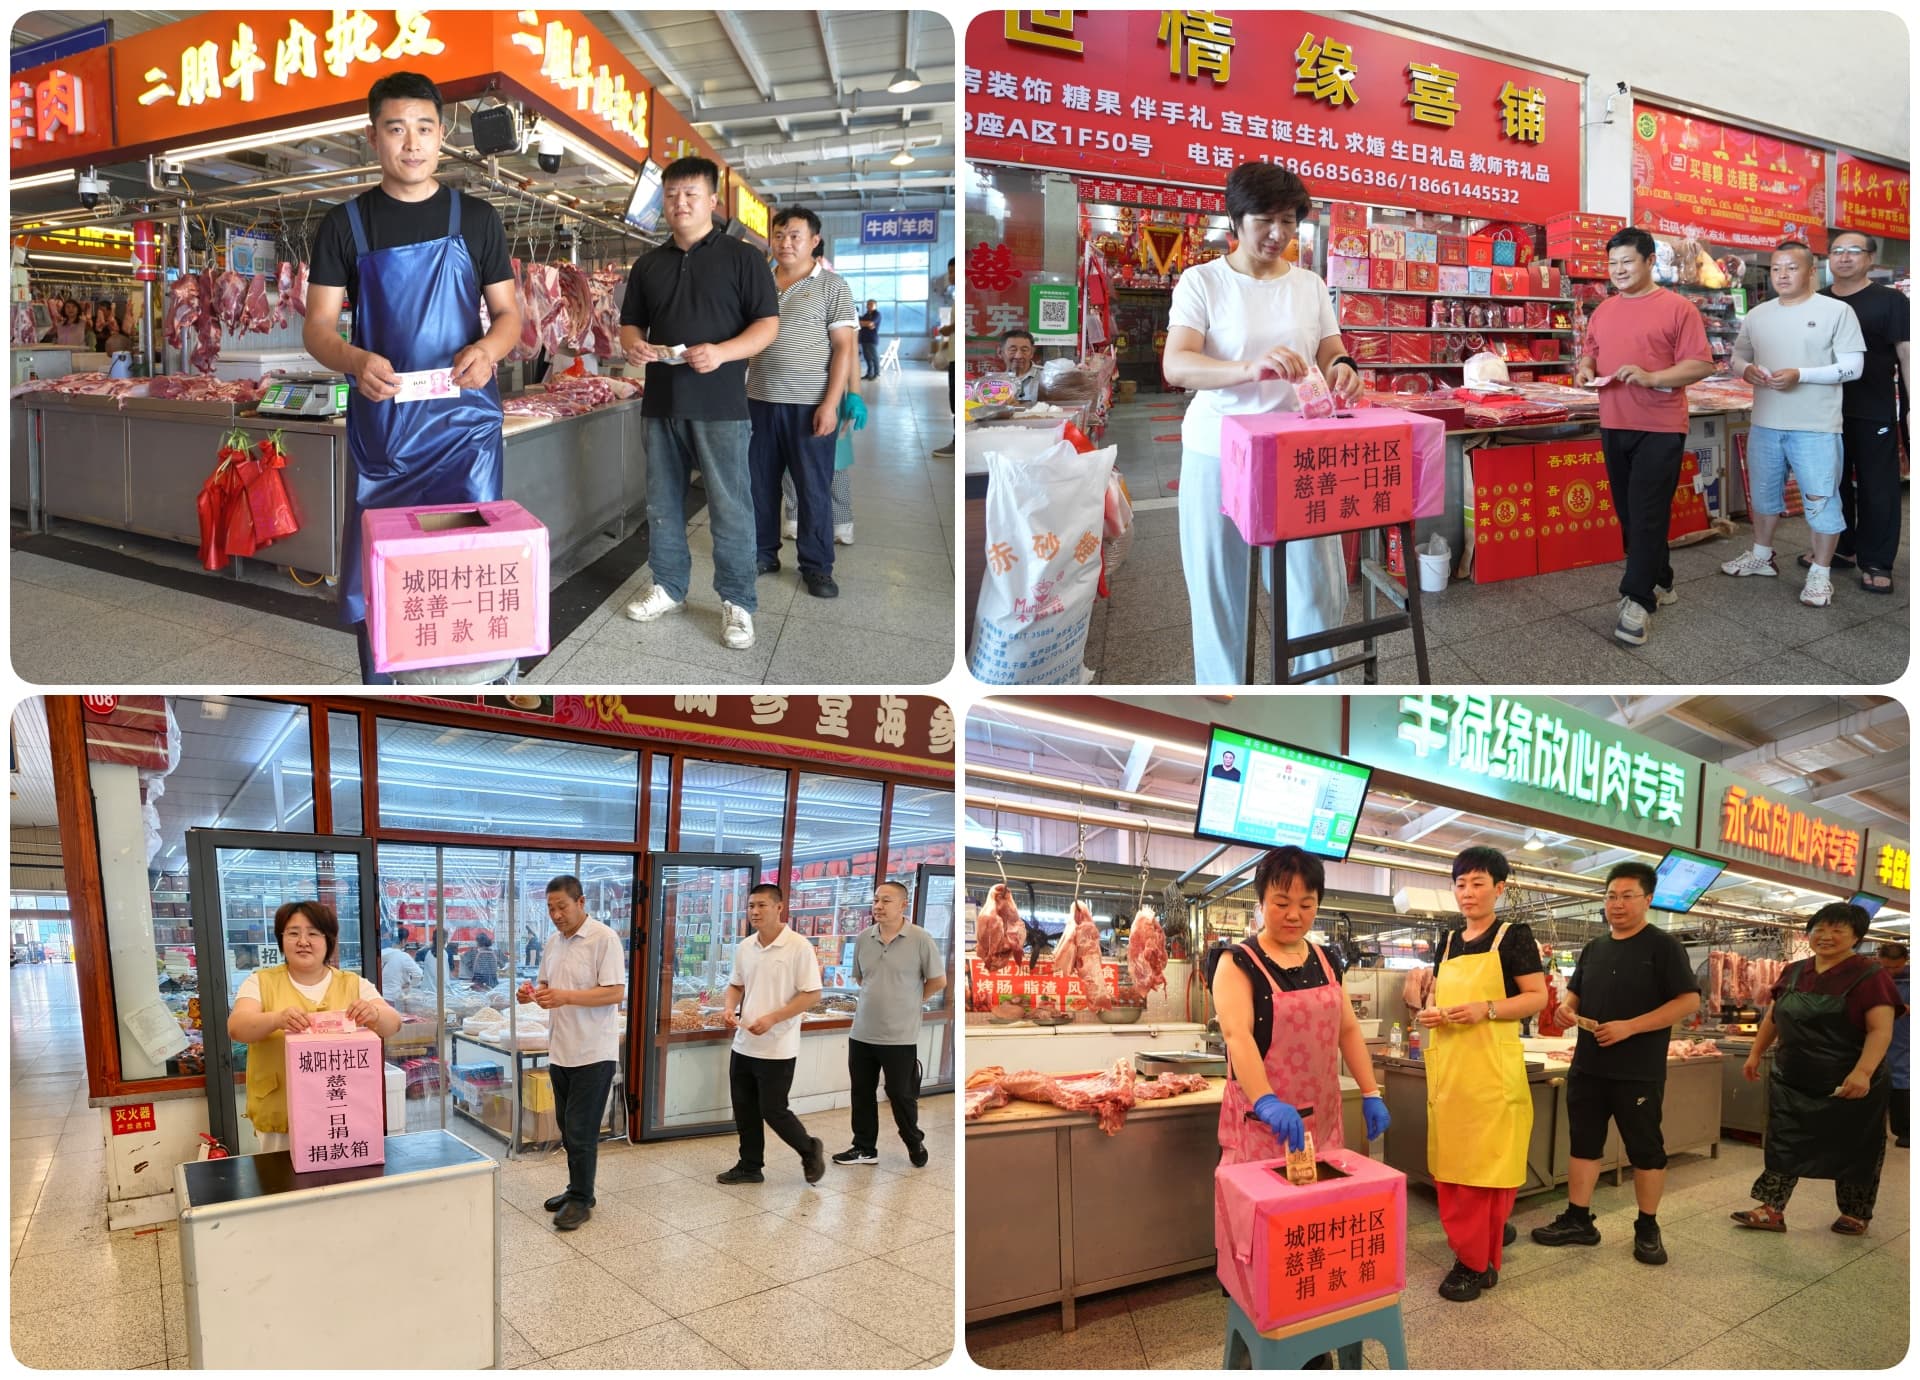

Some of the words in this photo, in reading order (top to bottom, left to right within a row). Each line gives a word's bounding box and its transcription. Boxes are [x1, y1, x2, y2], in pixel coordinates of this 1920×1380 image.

[138, 10, 445, 106] 二朋牛肉批发
[1062, 83, 1122, 116] 糖果
[1130, 96, 1213, 130] 伴手礼
[1221, 111, 1338, 151] 宝宝诞生礼
[1345, 132, 1386, 158] 求婚
[1391, 140, 1465, 170] 生日礼品
[1469, 153, 1550, 183] 教师节礼品
[867, 219, 898, 237] 牛肉
[901, 217, 934, 236] 羊肉
[1294, 440, 1400, 472] 城阳村社区
[1294, 465, 1400, 499] 慈善一日捐
[1305, 490, 1391, 524] 捐款箱
[402, 562, 519, 594] 城阳村社区
[403, 588, 520, 621] 慈善一日捐
[416, 615, 509, 647] 捐款箱
[1725, 784, 1860, 877] 永杰放心肉专卖
[976, 980, 1013, 995] 烤肠
[1024, 980, 1057, 995] 脂渣
[299, 1048, 370, 1073] 城阳村社区
[115, 1106, 151, 1122] 灭火器
[325, 1074, 349, 1139] 慈善一日捐
[308, 1140, 369, 1162] 捐款箱
[1285, 1208, 1385, 1250] 城阳村社区
[1285, 1233, 1385, 1277] 慈善一日捐
[1296, 1260, 1375, 1301] 捐款箱
